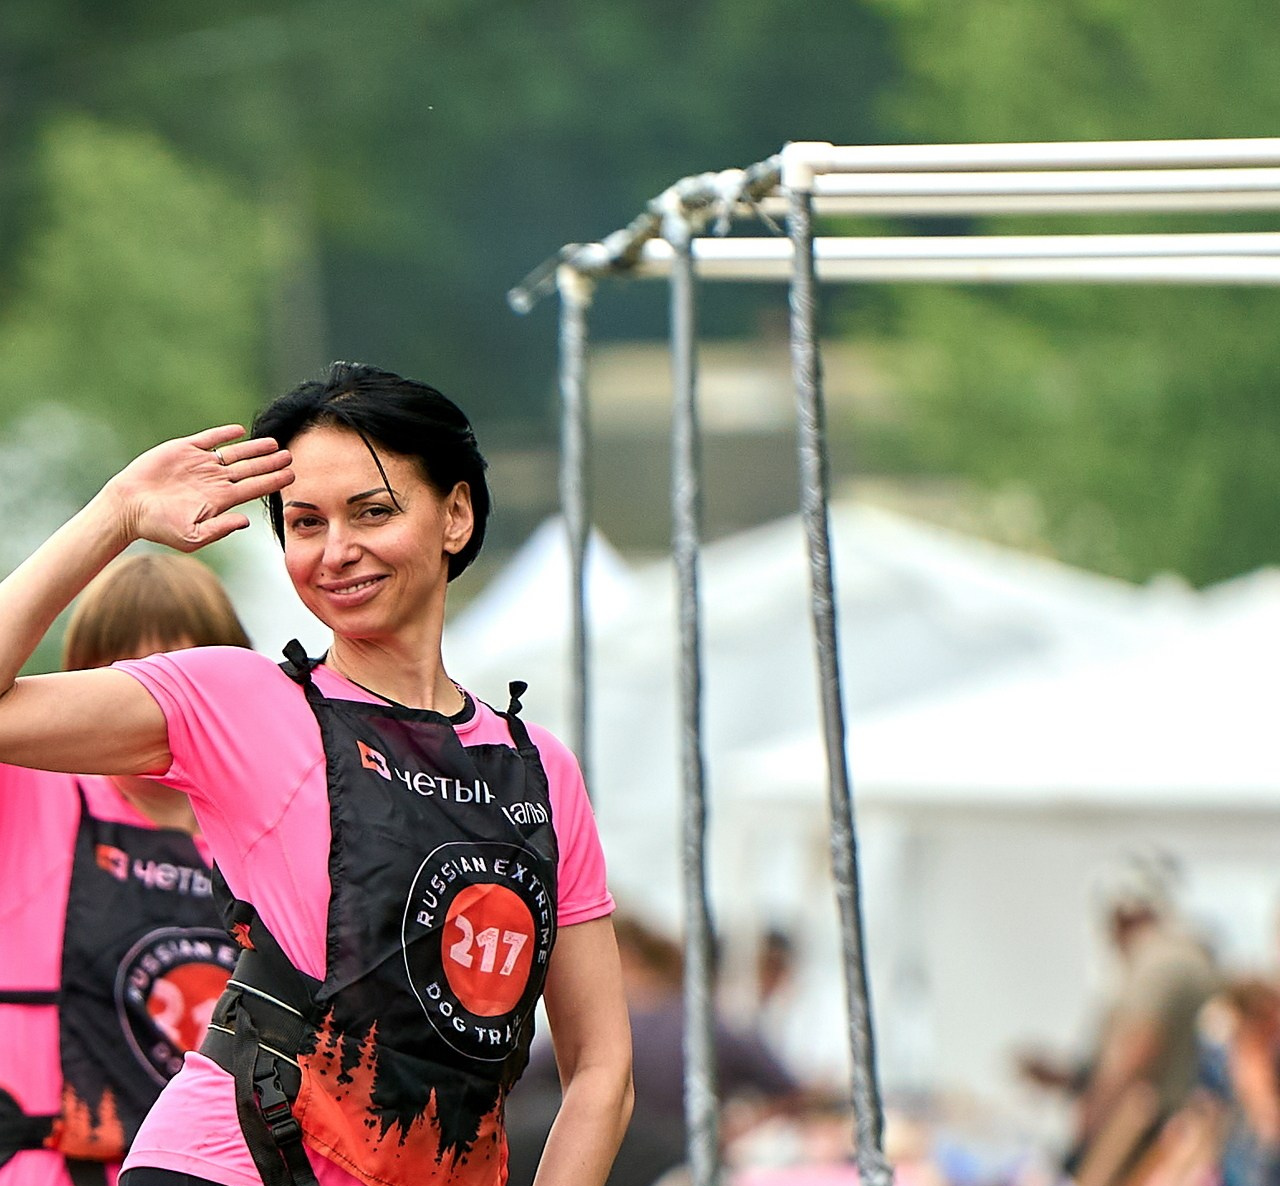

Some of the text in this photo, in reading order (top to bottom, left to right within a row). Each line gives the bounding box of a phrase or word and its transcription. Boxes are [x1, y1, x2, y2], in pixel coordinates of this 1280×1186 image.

[416, 856, 548, 965] RUSSIAN EXTREME
[449, 914, 528, 976] 217
[426, 981, 467, 1033] DOG
